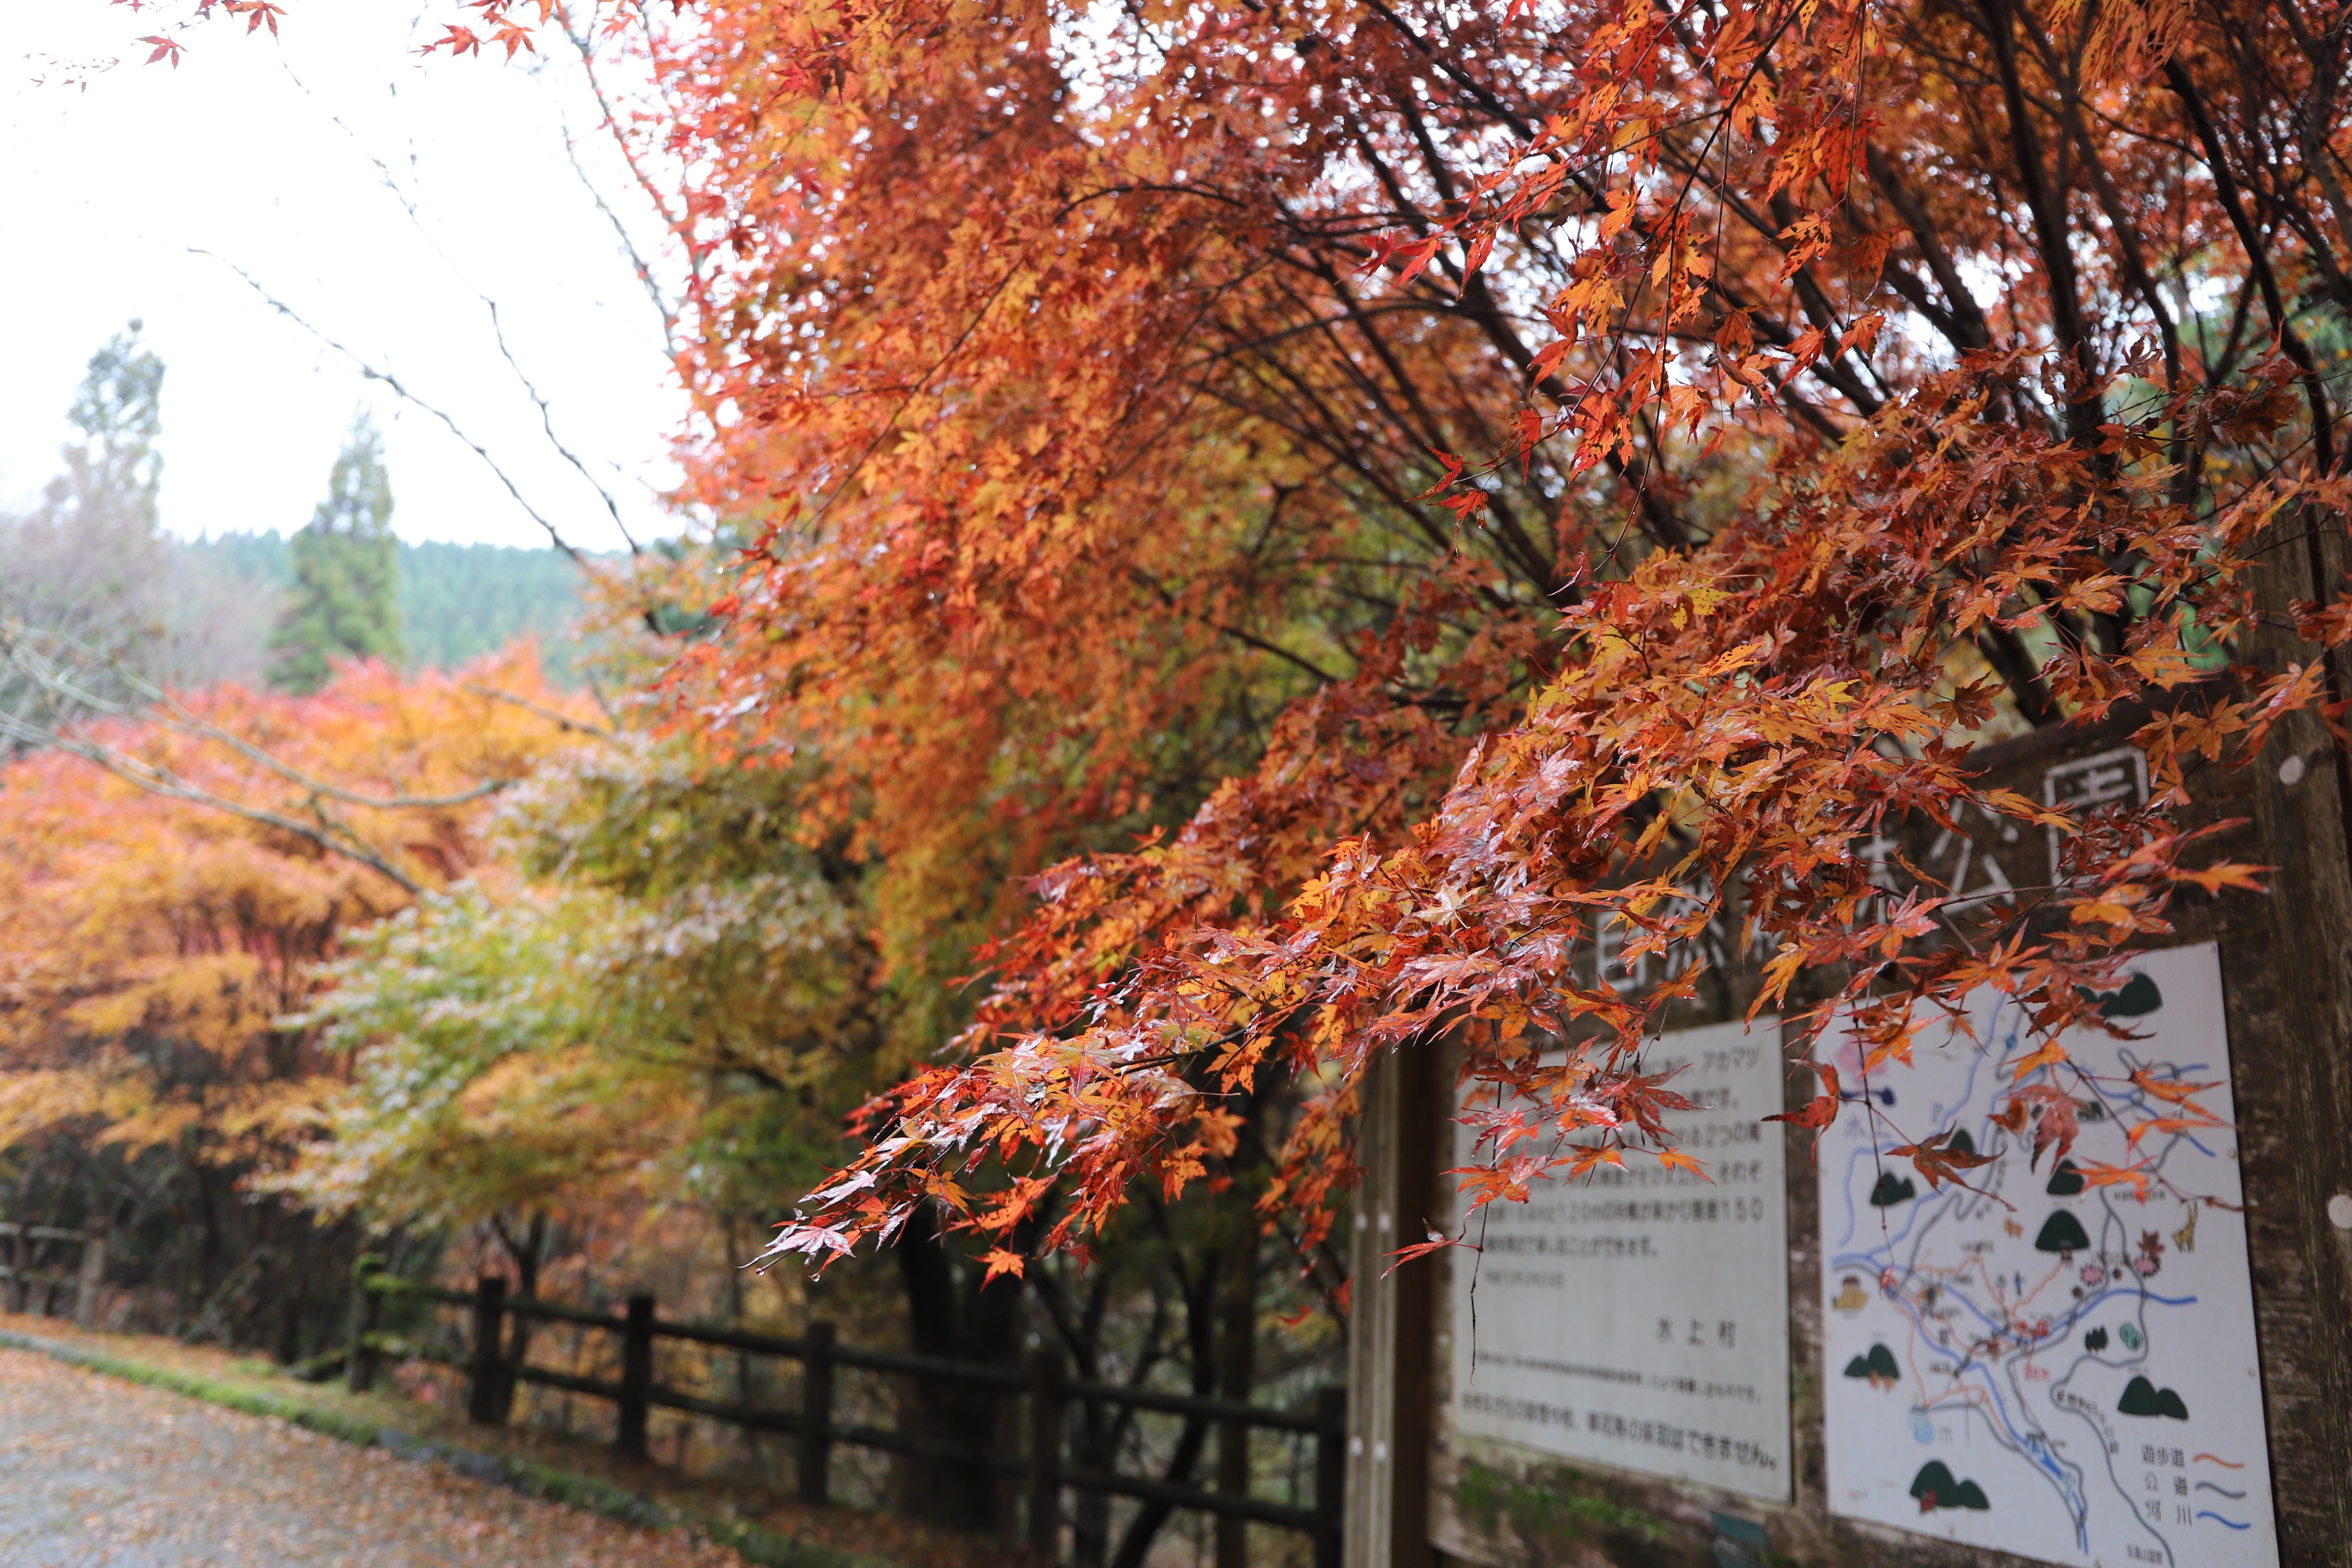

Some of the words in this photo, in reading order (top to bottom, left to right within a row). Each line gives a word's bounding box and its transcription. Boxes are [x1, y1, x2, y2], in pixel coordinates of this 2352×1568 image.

[1657, 1317, 1736, 1349] 水上村
[2142, 1444, 2186, 1467] 遊歩道
